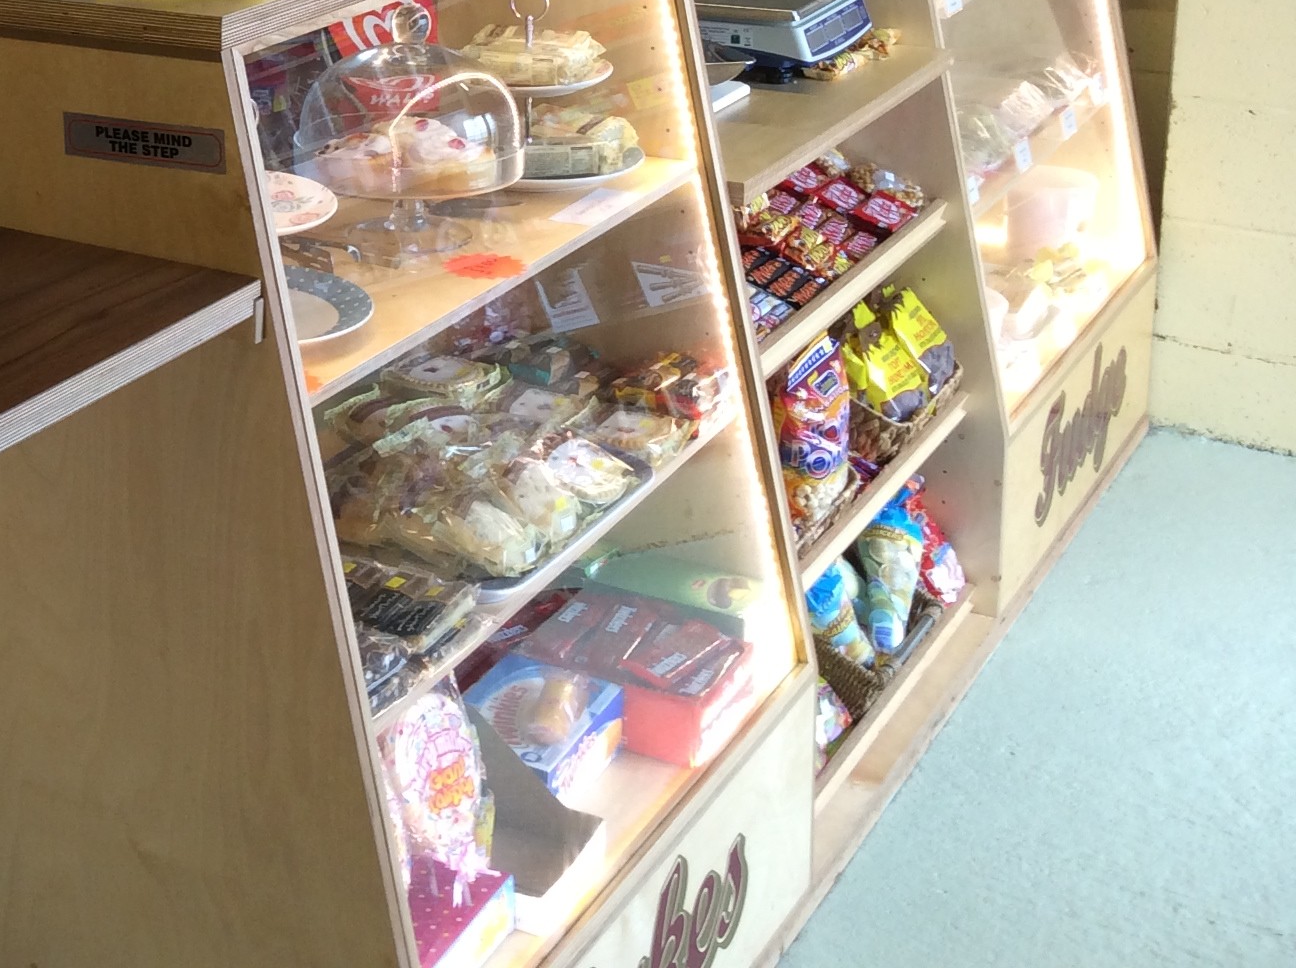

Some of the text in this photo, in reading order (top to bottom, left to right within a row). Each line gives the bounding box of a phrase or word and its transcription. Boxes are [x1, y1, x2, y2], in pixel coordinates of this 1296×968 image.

[95, 125, 192, 148] PLEASE MIND
[109, 140, 179, 159] THE STEP
[1034, 341, 1127, 527] Fudge
